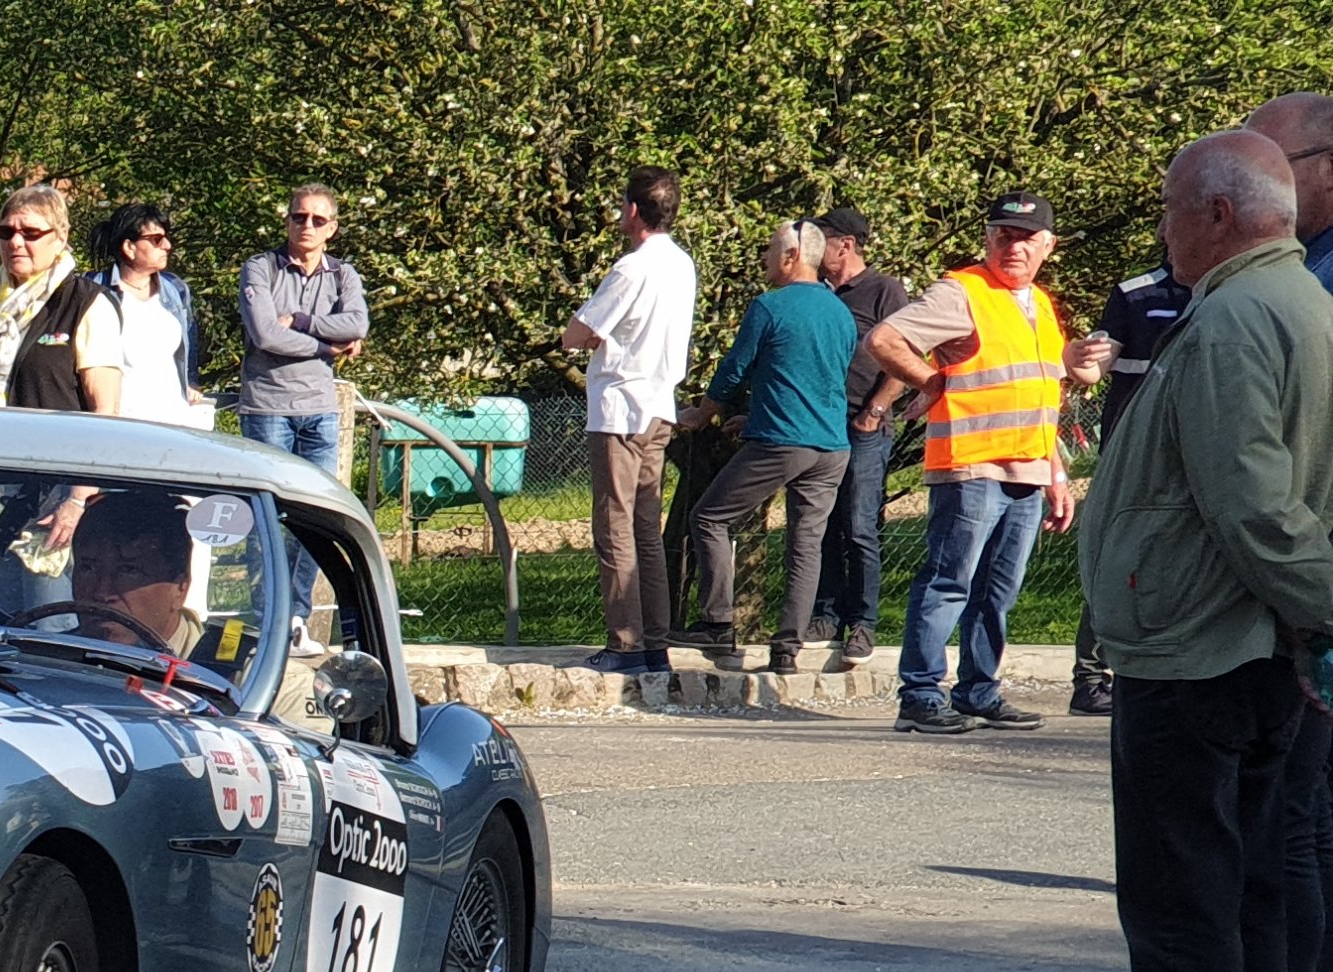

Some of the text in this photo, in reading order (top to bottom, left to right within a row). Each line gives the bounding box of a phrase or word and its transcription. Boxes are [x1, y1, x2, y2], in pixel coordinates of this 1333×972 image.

[206, 501, 238, 529] F
[329, 806, 372, 874] Optic
[369, 819, 408, 877] 2000
[255, 887, 277, 957] 65
